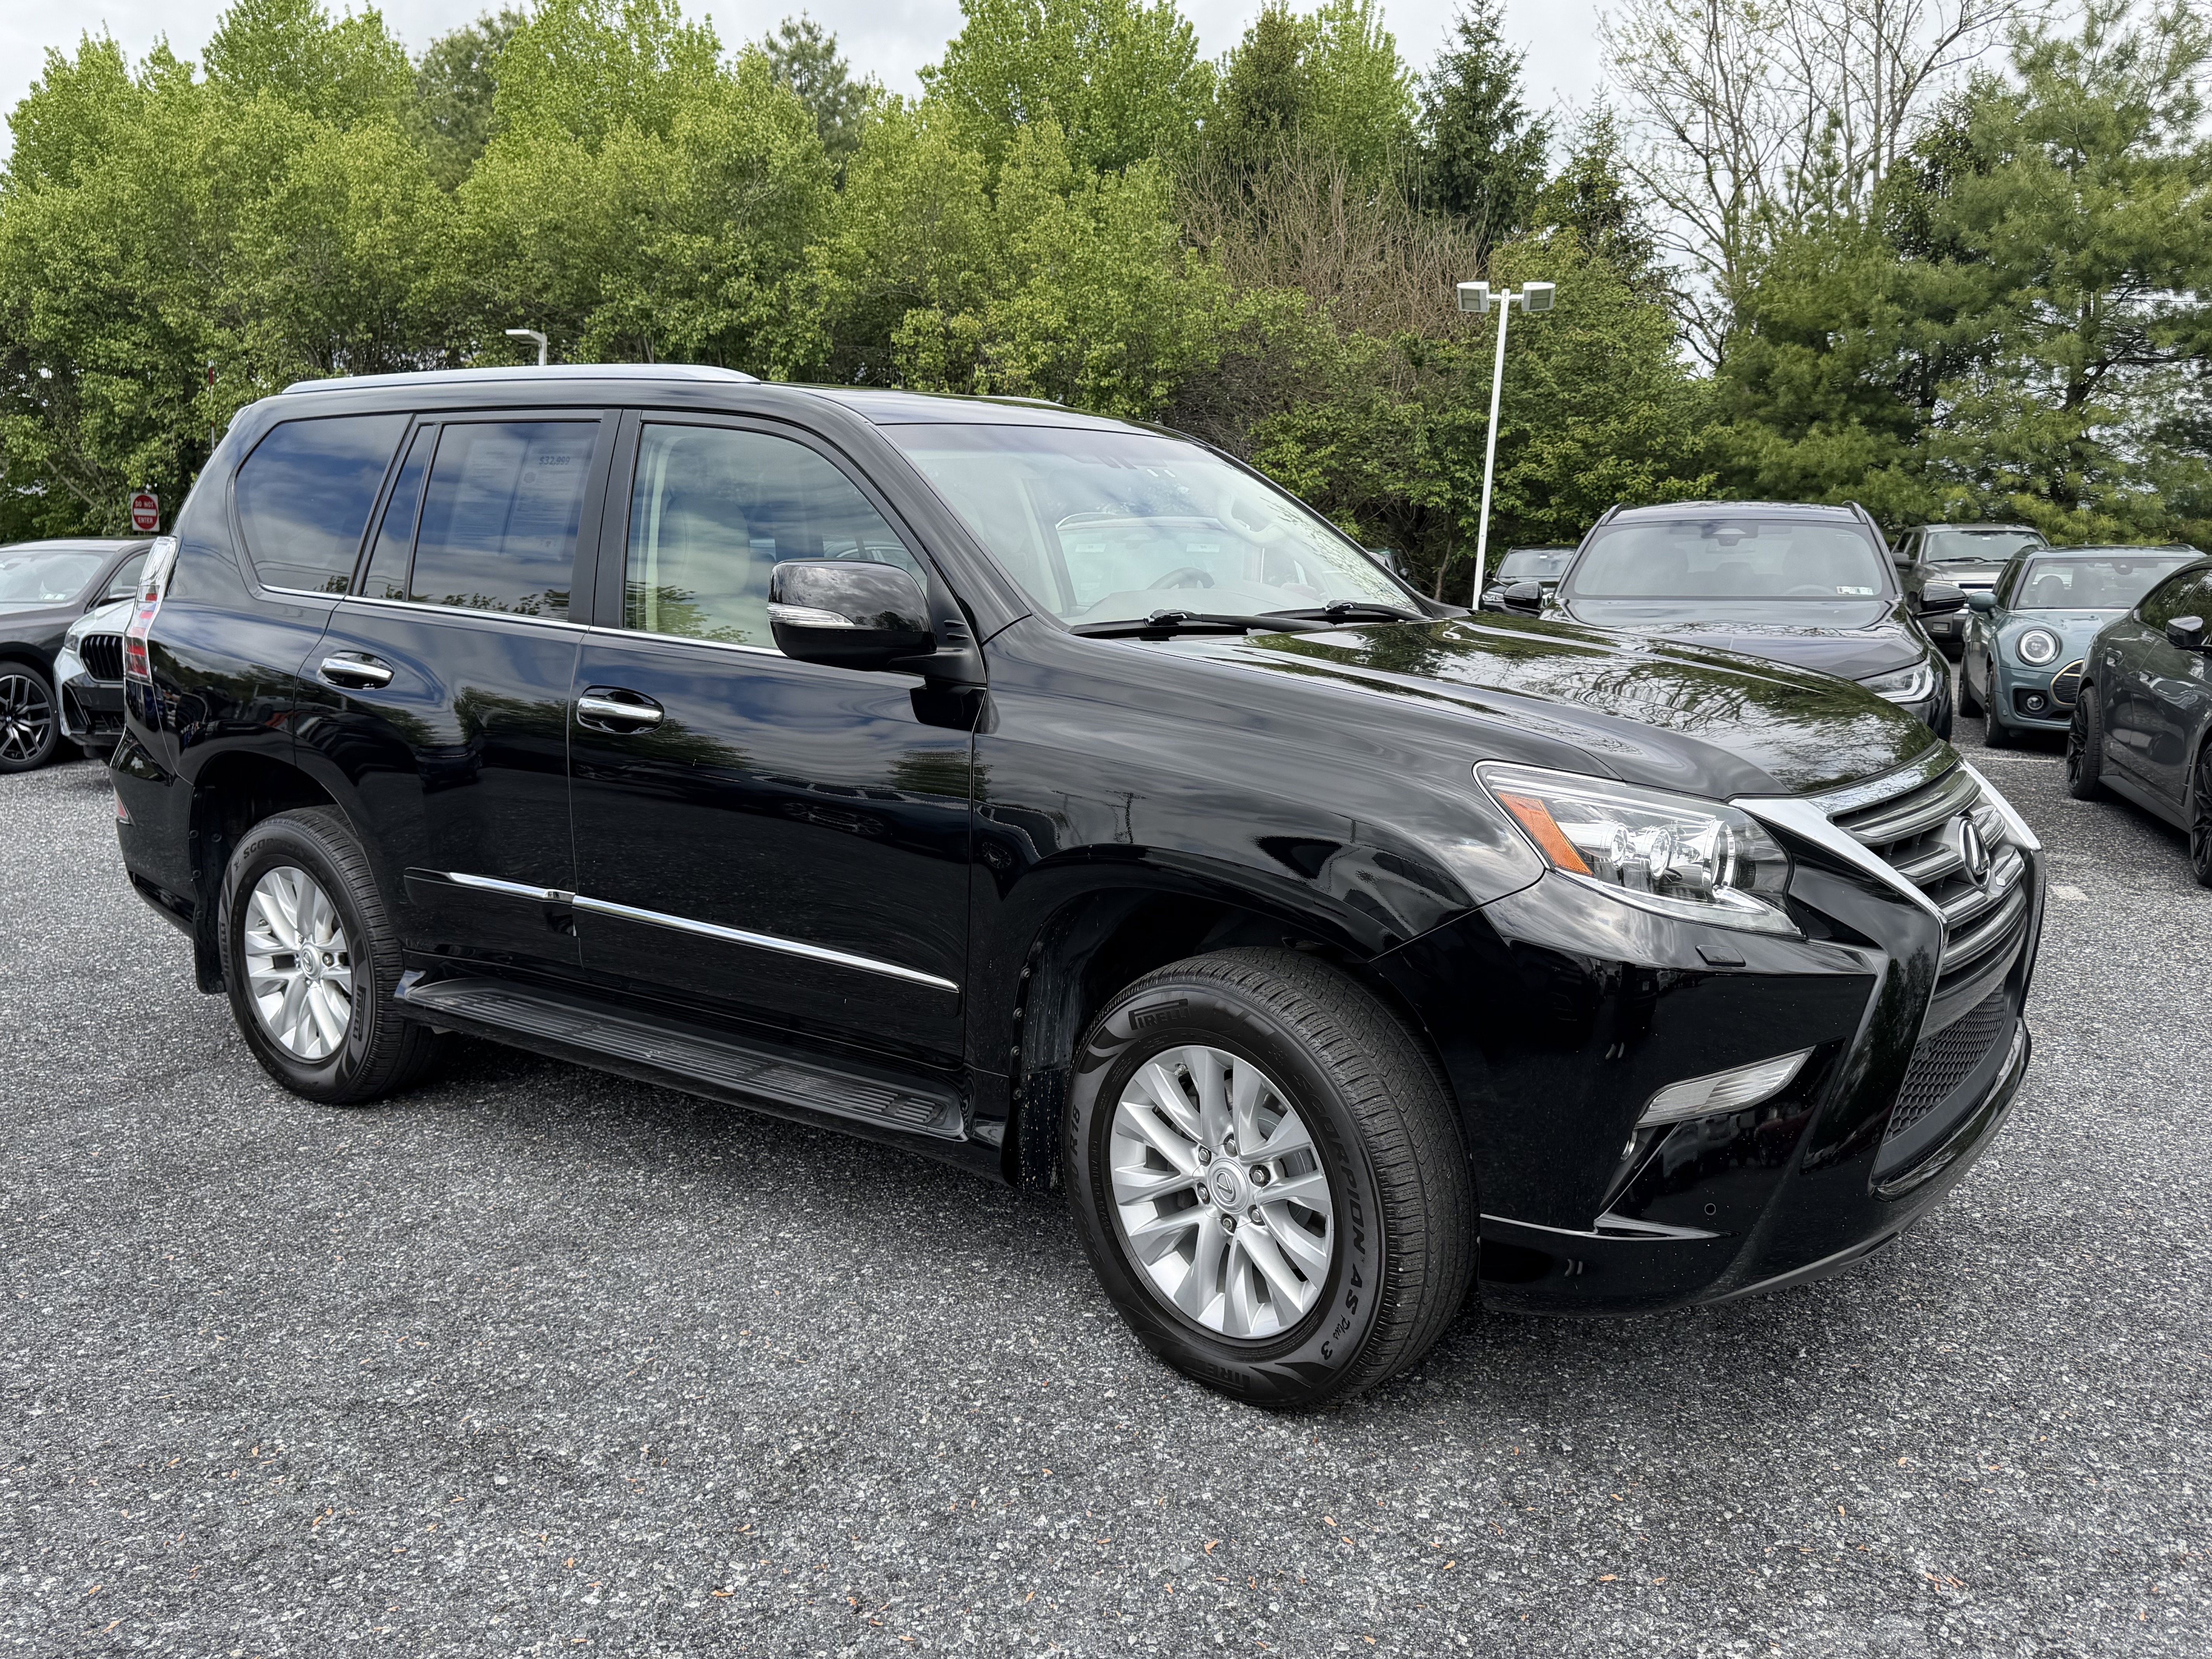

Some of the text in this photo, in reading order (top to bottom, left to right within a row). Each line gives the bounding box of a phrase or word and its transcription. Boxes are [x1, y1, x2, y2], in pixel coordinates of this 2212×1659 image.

[539, 455, 570, 466] $32,999
[352, 984, 367, 1042] PIRELLI
[1128, 998, 1191, 1030] PIRELLI
[1069, 1104, 1080, 1156] R18
[1345, 1262, 1363, 1316] AS
[1333, 1314, 1352, 1341] Plus
[1321, 1340, 1333, 1360] 3
